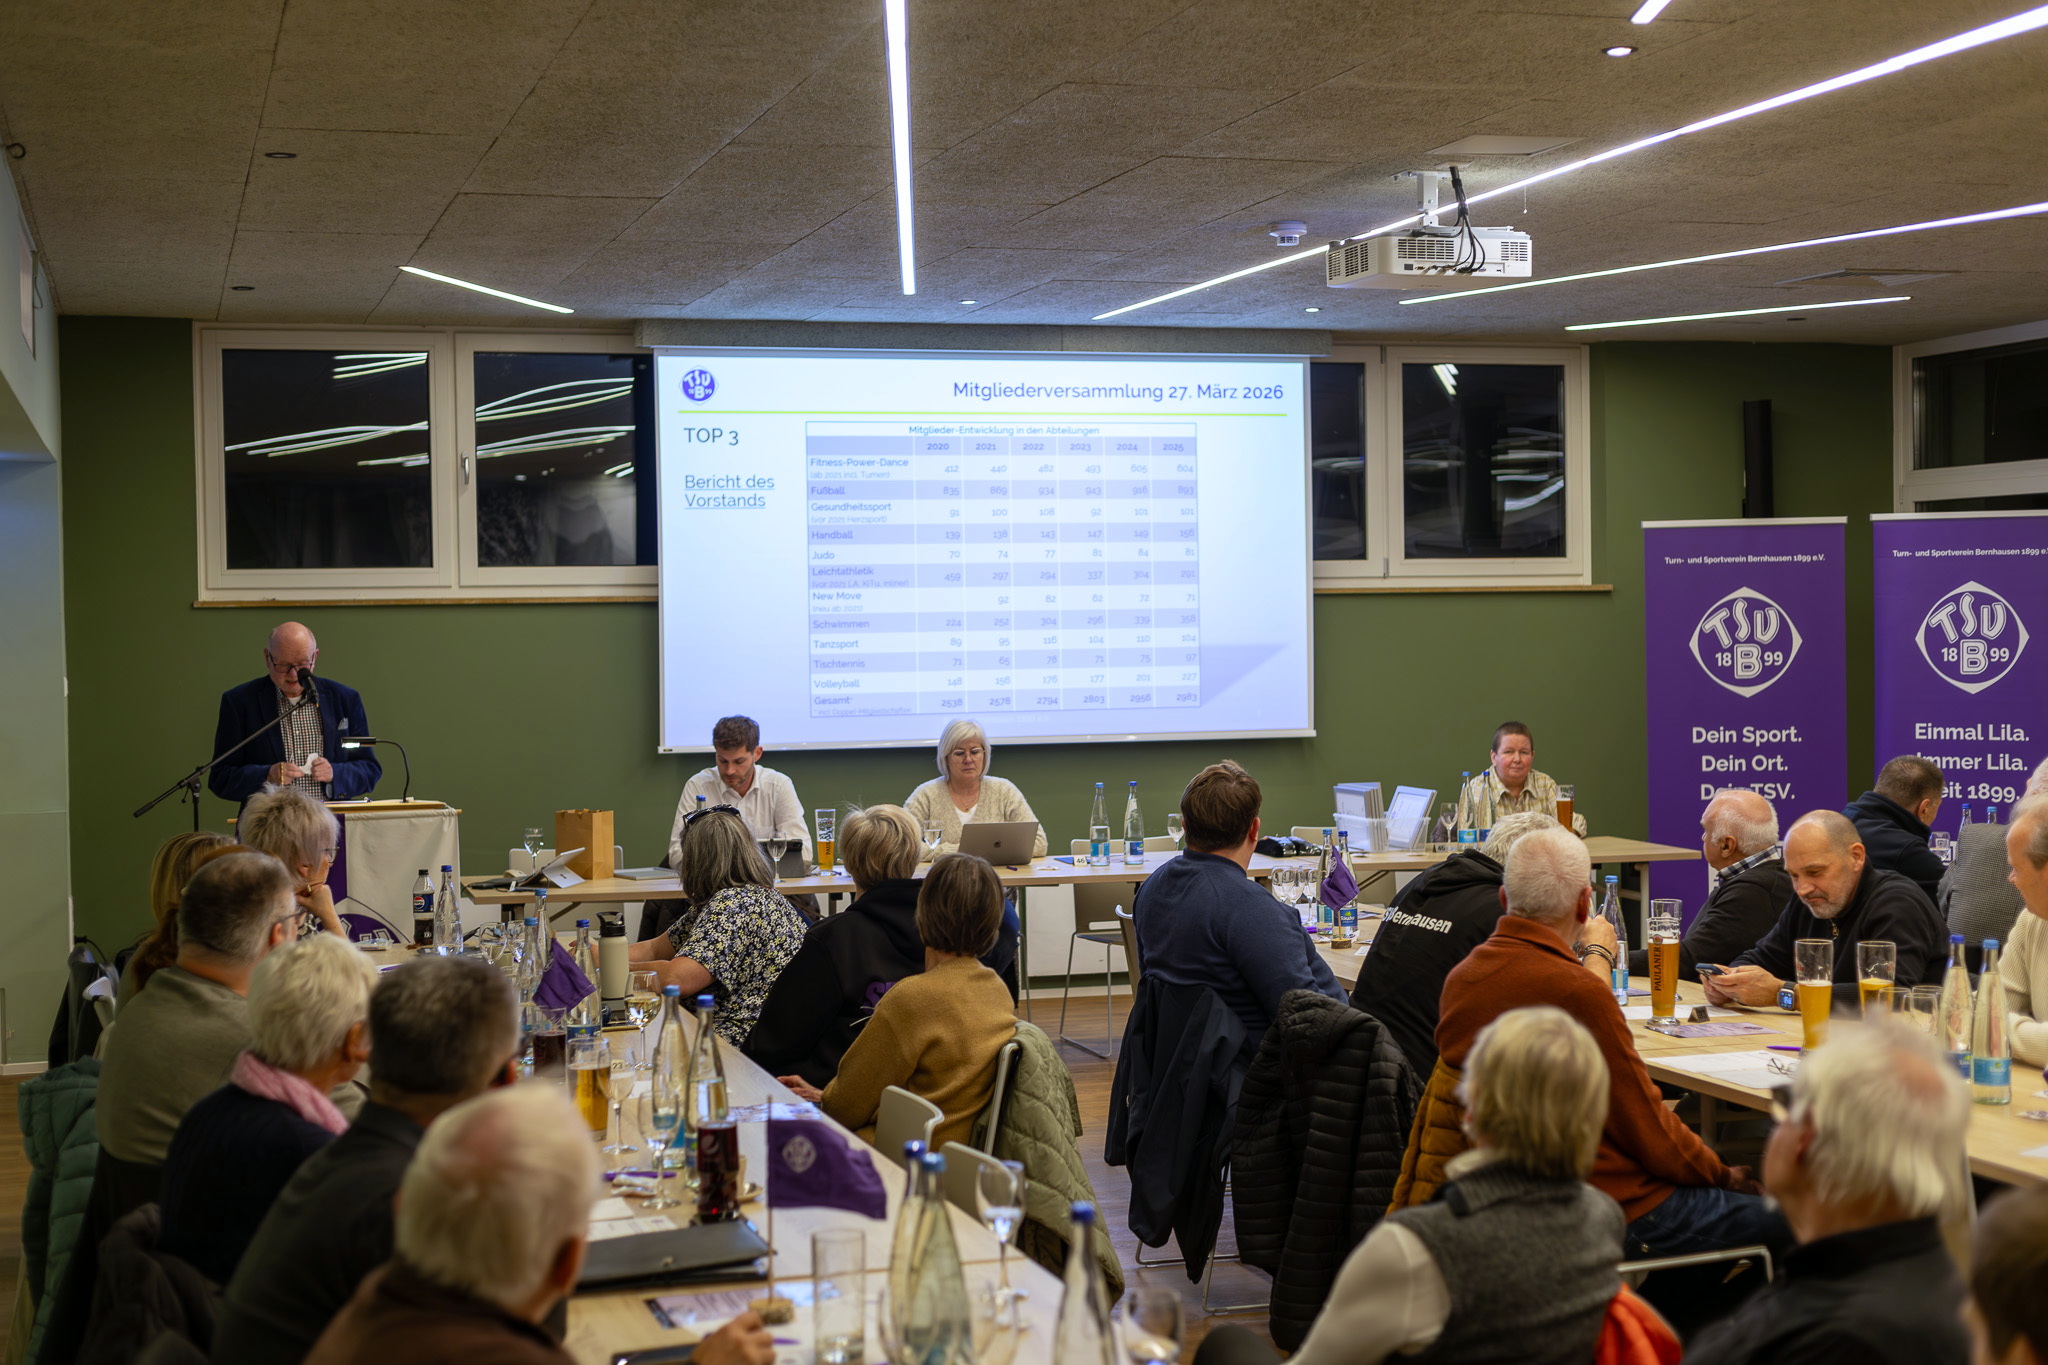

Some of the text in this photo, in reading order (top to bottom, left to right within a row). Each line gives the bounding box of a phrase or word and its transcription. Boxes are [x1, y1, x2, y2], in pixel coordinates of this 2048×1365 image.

[684, 370, 712, 388] TSV
[694, 386, 705, 399] B
[953, 382, 1284, 402] Mitgliederversammlung 27. März 2026
[684, 428, 739, 446] TOP 3
[908, 426, 1014, 436] Mitglieder-Entwicklung
[1026, 426, 1044, 434] den
[1046, 426, 1100, 436] Abteilungen
[926, 442, 950, 450] 2020
[1070, 443, 1092, 452] 2023
[1116, 443, 1138, 452] 2024
[1162, 443, 1184, 452] 2025
[810, 458, 908, 468] Fitness-Power-Dance
[684, 474, 775, 489] Bericht des
[810, 486, 845, 496] Fußball
[684, 494, 766, 508] Vorstands
[810, 502, 892, 512] Gesundheitssport
[812, 530, 854, 540] Handball
[812, 551, 836, 560] Judo
[1664, 554, 1826, 565] Turn- und Sportverein Bernhausen 1899 e.V.
[1892, 550, 1912, 558] Turn-
[1931, 549, 1974, 558] Sportverein
[1975, 548, 2020, 556] Bernhausen
[2022, 548, 2040, 556] 1899
[812, 566, 874, 576] Leichtathletik
[812, 592, 862, 600] New Move
[812, 620, 870, 629] Schwimmen
[1702, 598, 1780, 649] TSV
[1928, 592, 2007, 644] TSV
[814, 640, 859, 650] Tanzsport
[1714, 644, 1784, 679] 18 B 99
[1941, 638, 2010, 675] 18 B 99
[814, 659, 866, 668] Tischtennis
[814, 679, 860, 689] Volleyball
[1692, 726, 1802, 748] Dein Sport.
[1914, 722, 2030, 742] Einmal Lila.
[1702, 754, 1788, 772] Dein Ort.
[1986, 753, 2028, 771] Lila.
[1941, 782, 2020, 804] eit 1899.
[1654, 946, 1662, 991] PAULANER
